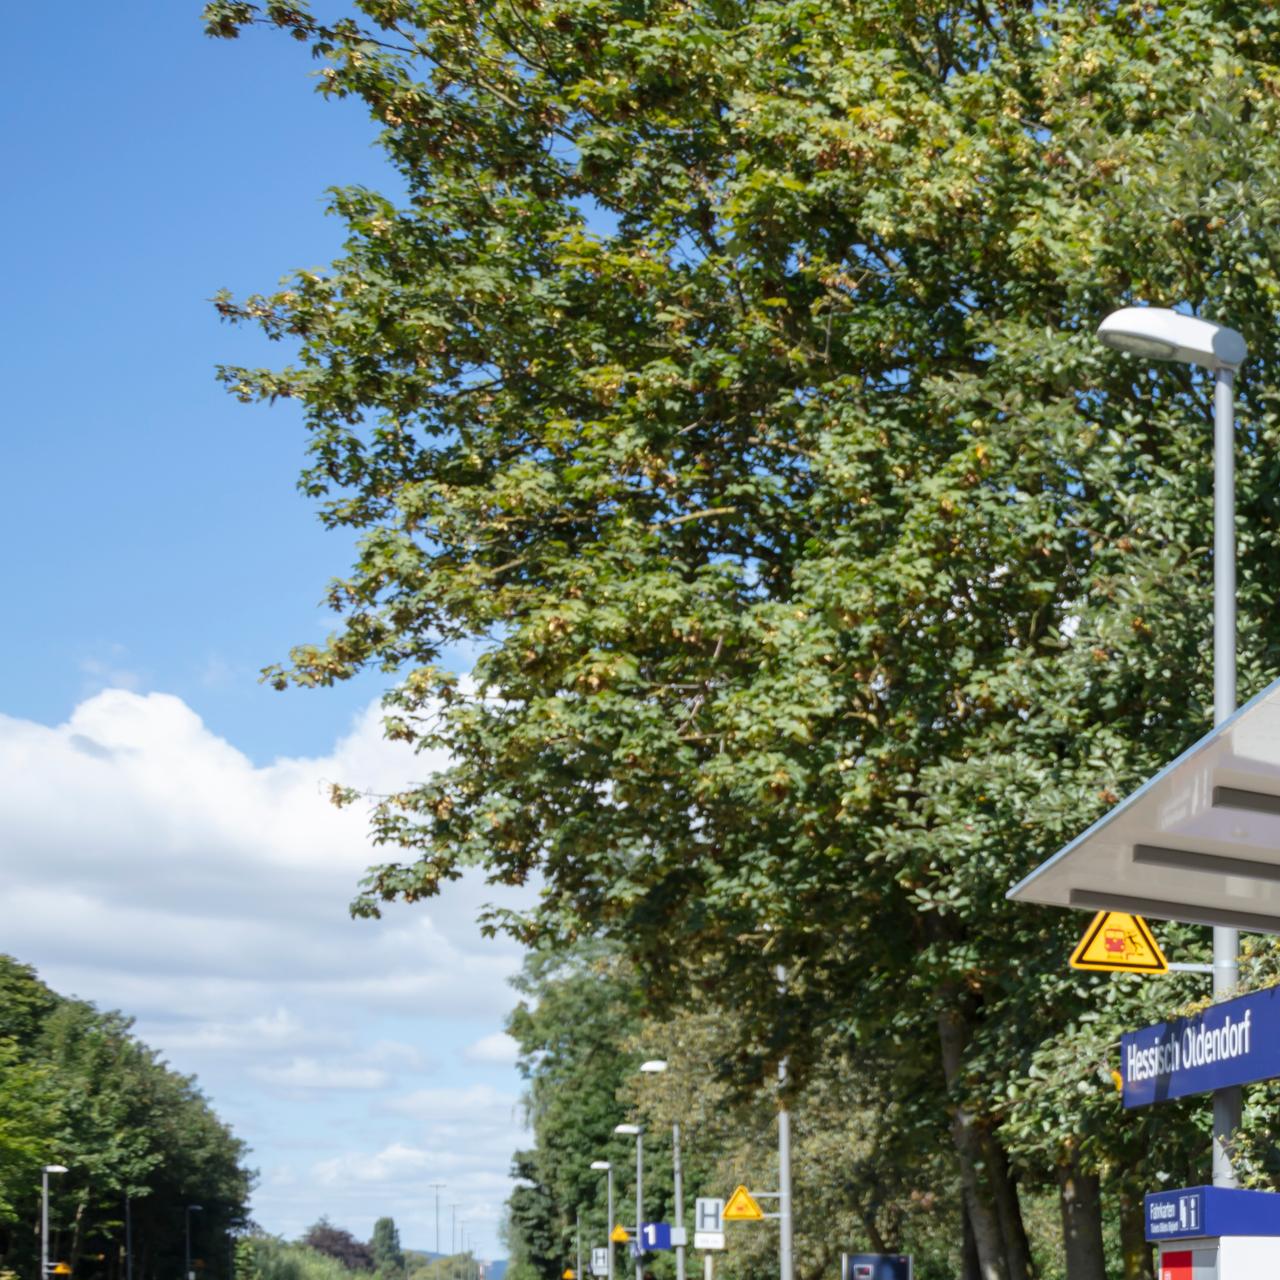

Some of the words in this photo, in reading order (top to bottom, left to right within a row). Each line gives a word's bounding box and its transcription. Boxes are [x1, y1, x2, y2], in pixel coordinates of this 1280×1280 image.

[1127, 1036, 1180, 1082] Hessisch
[1182, 1009, 1251, 1070] Oldendorf
[700, 1202, 719, 1229] H
[643, 1224, 656, 1246] 1
